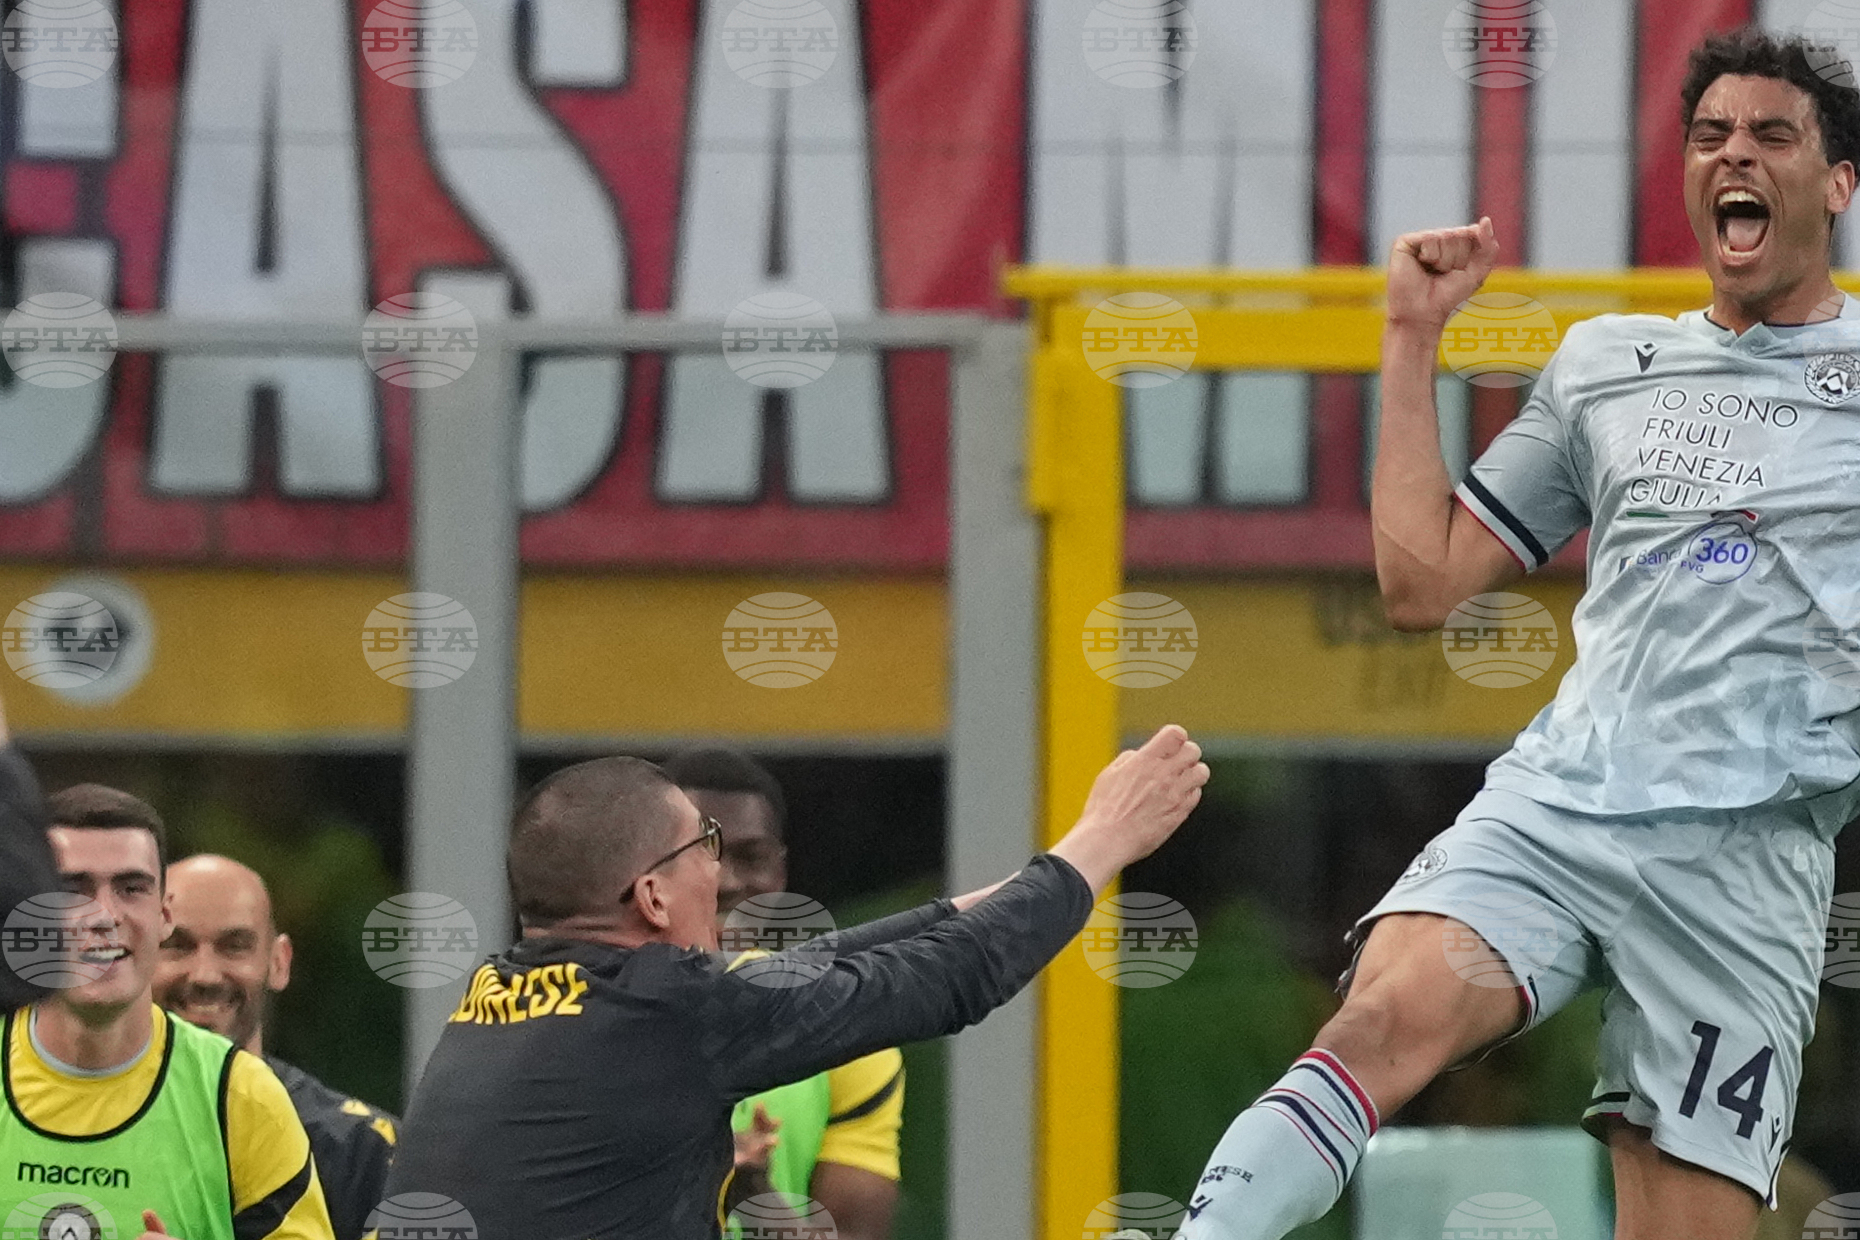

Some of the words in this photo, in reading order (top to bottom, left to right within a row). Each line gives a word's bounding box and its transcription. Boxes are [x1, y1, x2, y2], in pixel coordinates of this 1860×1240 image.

[1651, 388, 1687, 411] IO
[1697, 393, 1799, 428] SONO
[1642, 417, 1732, 450] FRIULI
[1636, 446, 1766, 488] VENEZIA
[1694, 537, 1749, 566] 360
[1678, 1019, 1775, 1140] 14
[18, 1161, 130, 1189] macron
